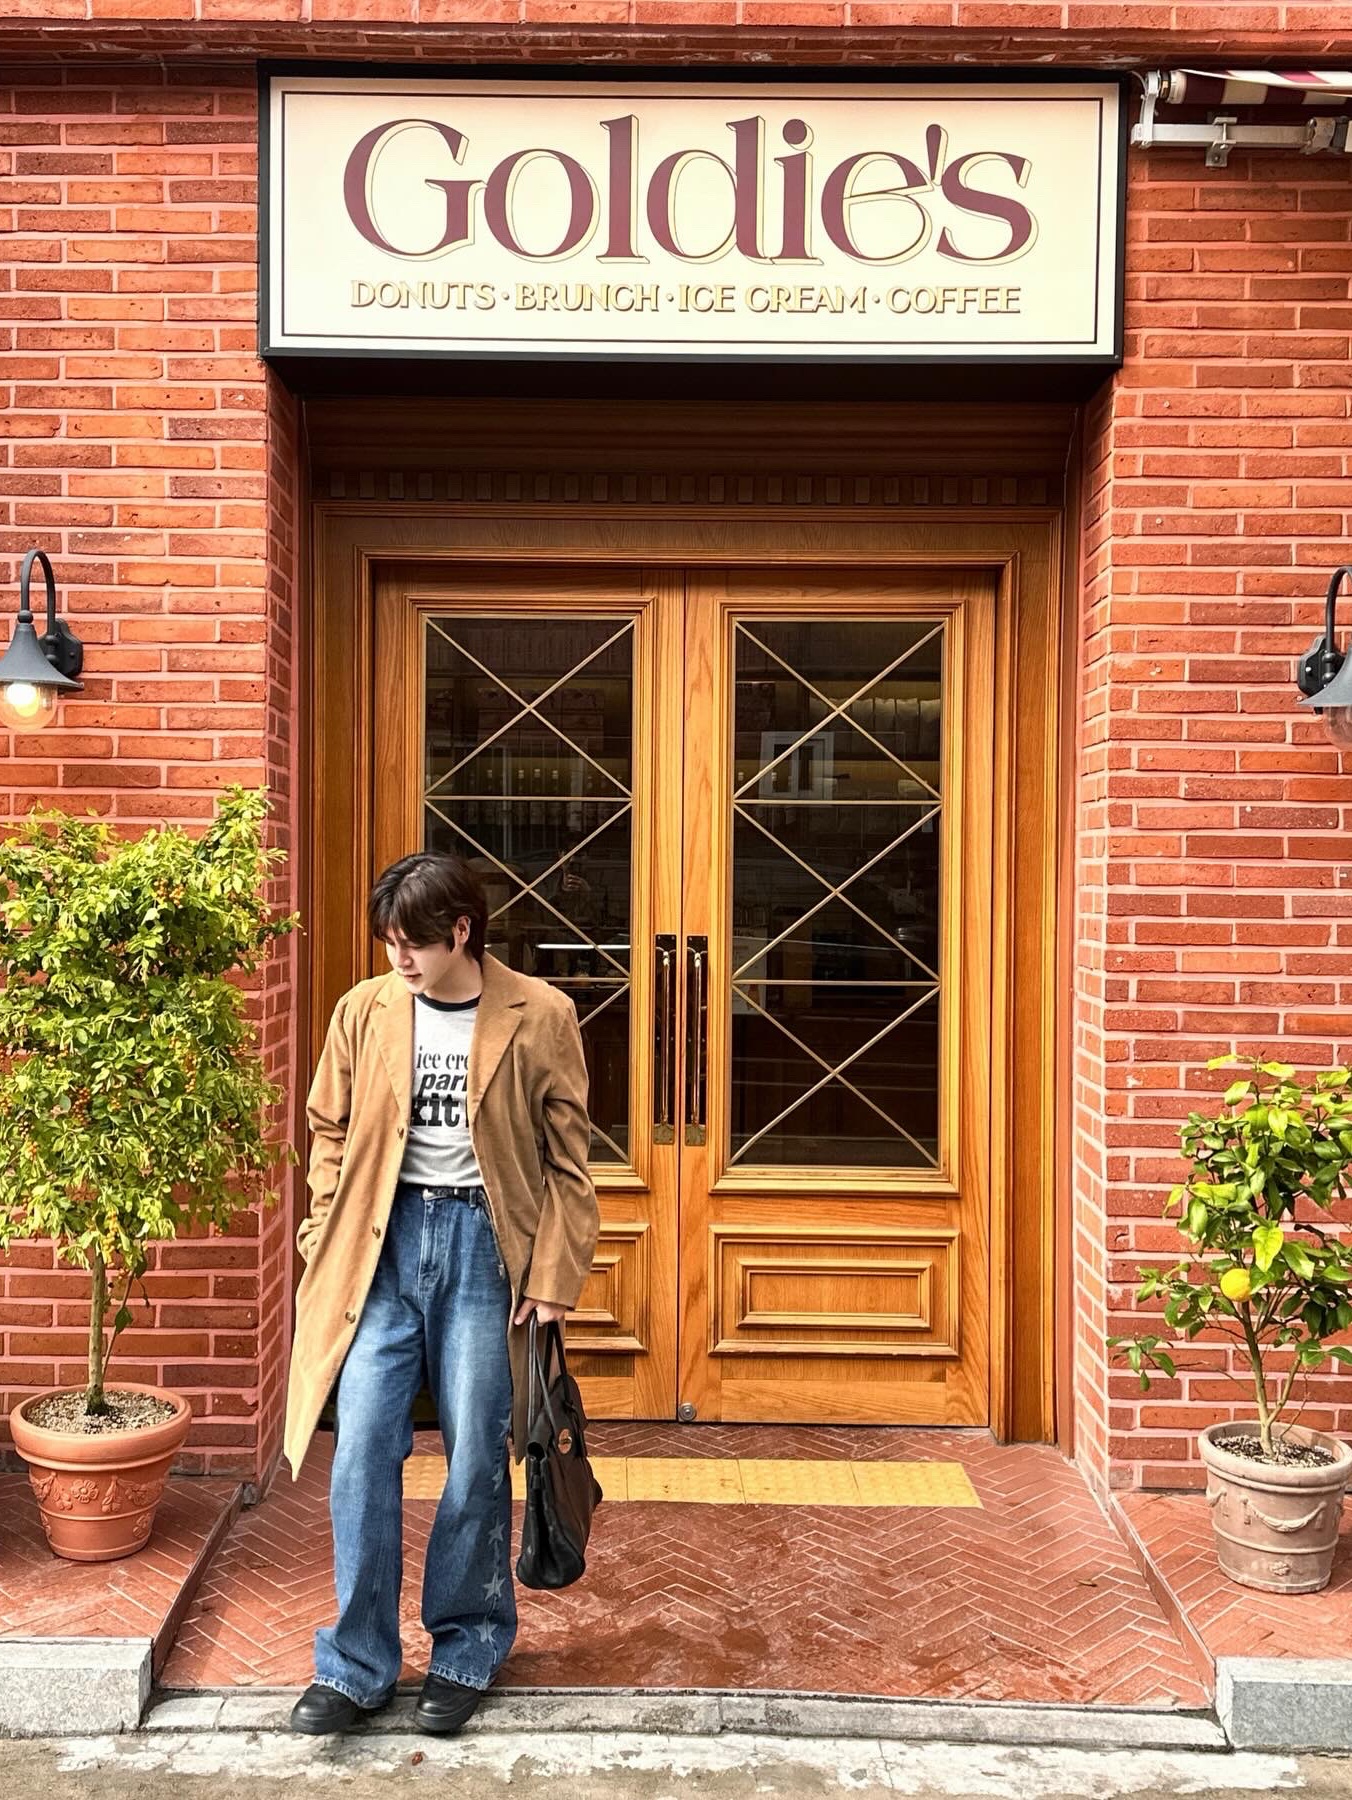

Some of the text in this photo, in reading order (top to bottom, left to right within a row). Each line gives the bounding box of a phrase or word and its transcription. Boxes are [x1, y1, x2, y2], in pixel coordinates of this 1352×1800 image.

[343, 114, 1039, 267] Goldie's
[678, 284, 736, 313] ICE
[745, 285, 867, 314] CREAM
[886, 286, 1021, 314] COFFEE
[416, 1045, 441, 1069] ice
